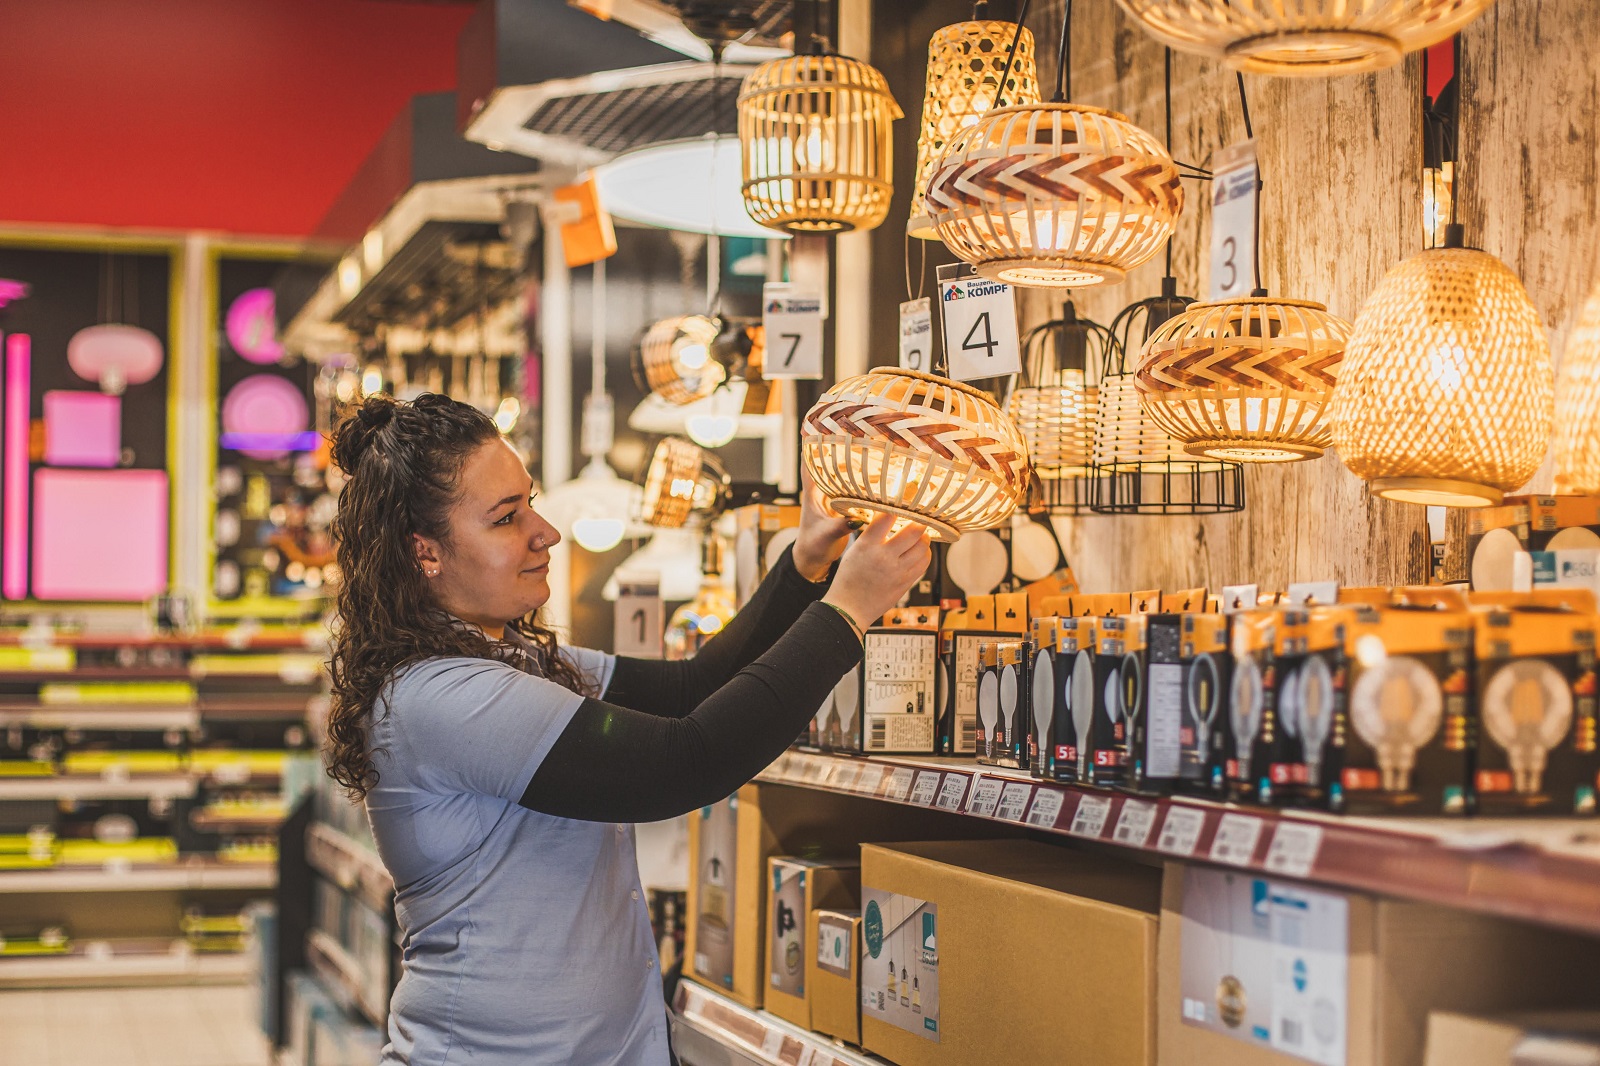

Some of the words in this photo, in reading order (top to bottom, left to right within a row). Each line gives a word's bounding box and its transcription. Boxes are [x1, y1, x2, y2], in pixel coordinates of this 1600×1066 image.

[1221, 236, 1237, 291] 3
[780, 333, 801, 367] 7
[962, 312, 998, 357] 4
[631, 608, 646, 643] 1
